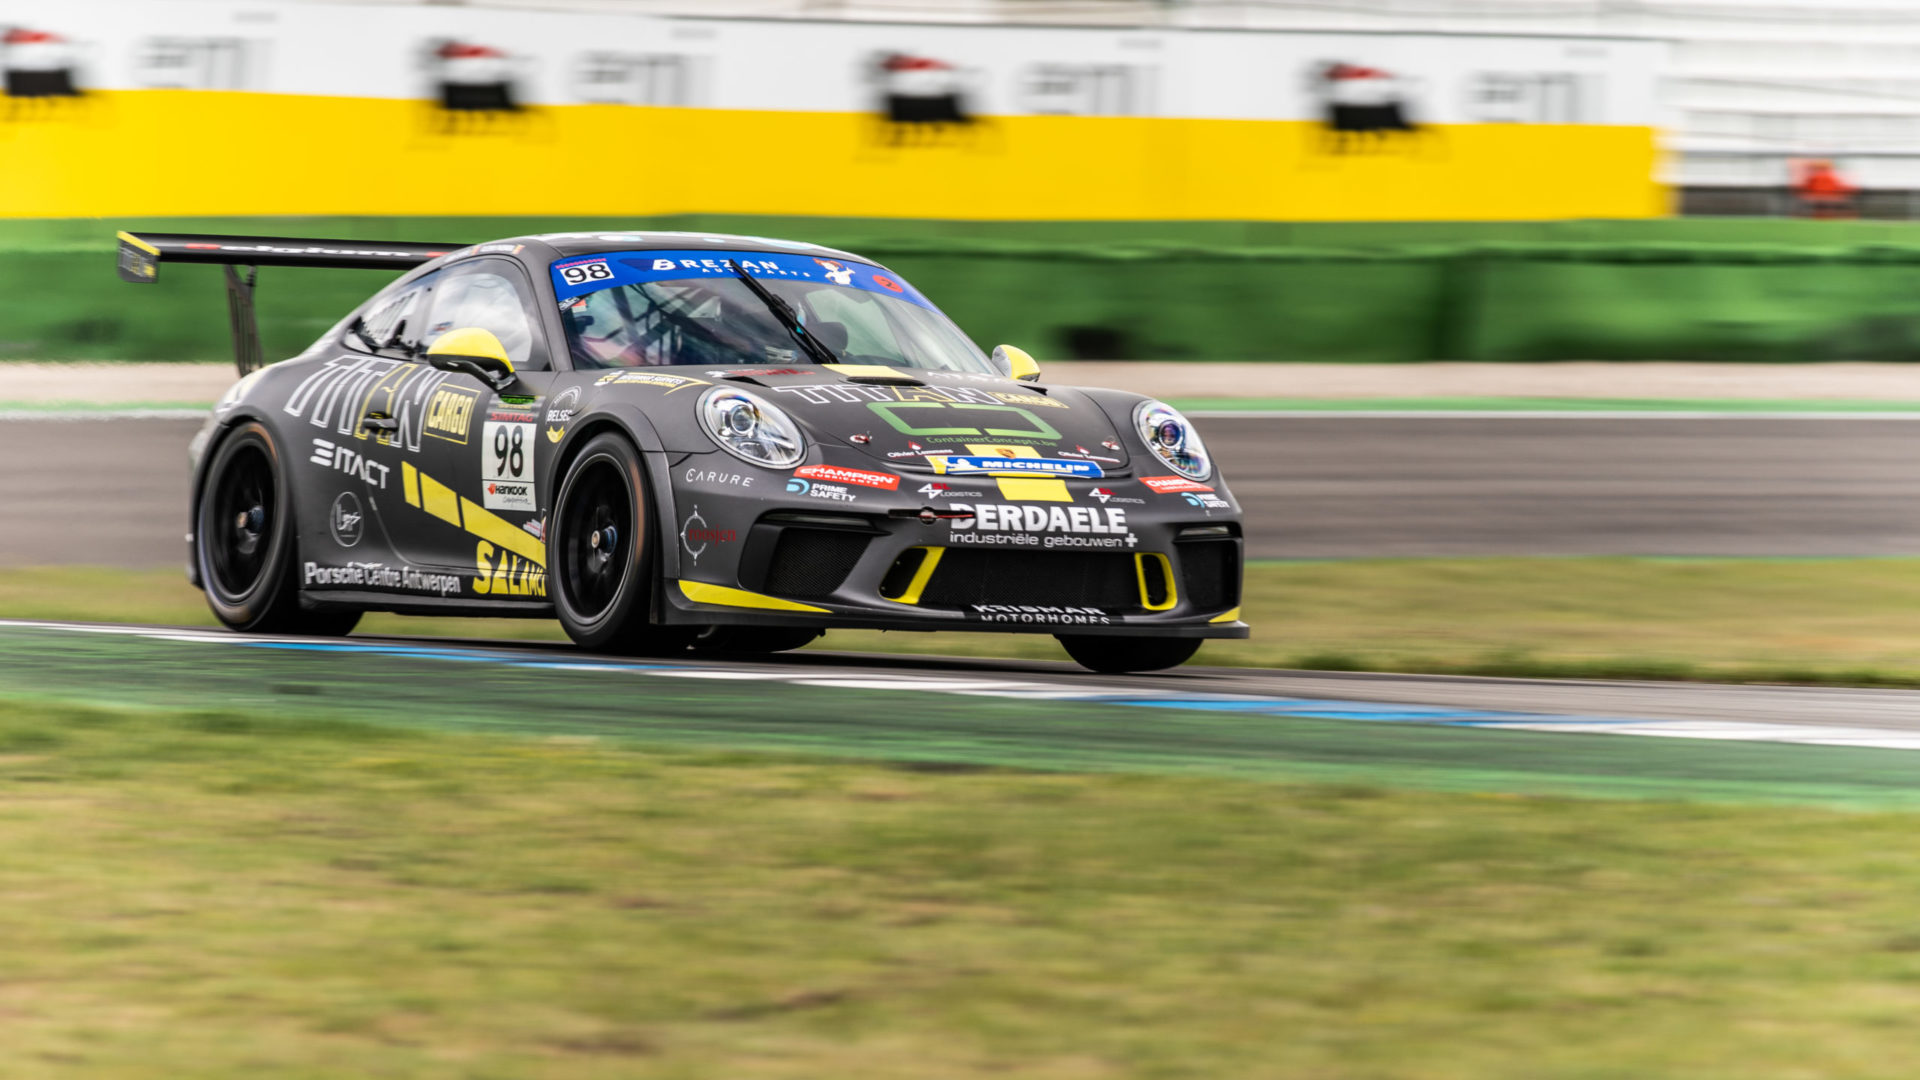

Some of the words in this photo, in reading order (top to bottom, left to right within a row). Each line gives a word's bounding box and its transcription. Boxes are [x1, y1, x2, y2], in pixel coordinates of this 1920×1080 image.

[564, 263, 611, 284] 98
[652, 258, 779, 271] BREZAN
[771, 384, 1005, 405] TITAN
[427, 389, 473, 436] CARGO
[495, 424, 524, 478] 98
[800, 467, 895, 484] CHAMPION
[982, 460, 1090, 472] MICHELIN
[686, 467, 755, 488] CARURE
[810, 489, 856, 502] SAFETY
[811, 483, 848, 494] PRIME
[949, 503, 1128, 534] DERDAELE
[949, 532, 1040, 545] industriële
[1044, 535, 1123, 548] gebouwen
[304, 561, 364, 585] Porsche
[402, 566, 462, 597] Antwerpen
[981, 613, 1111, 625] MOTORHOMES
